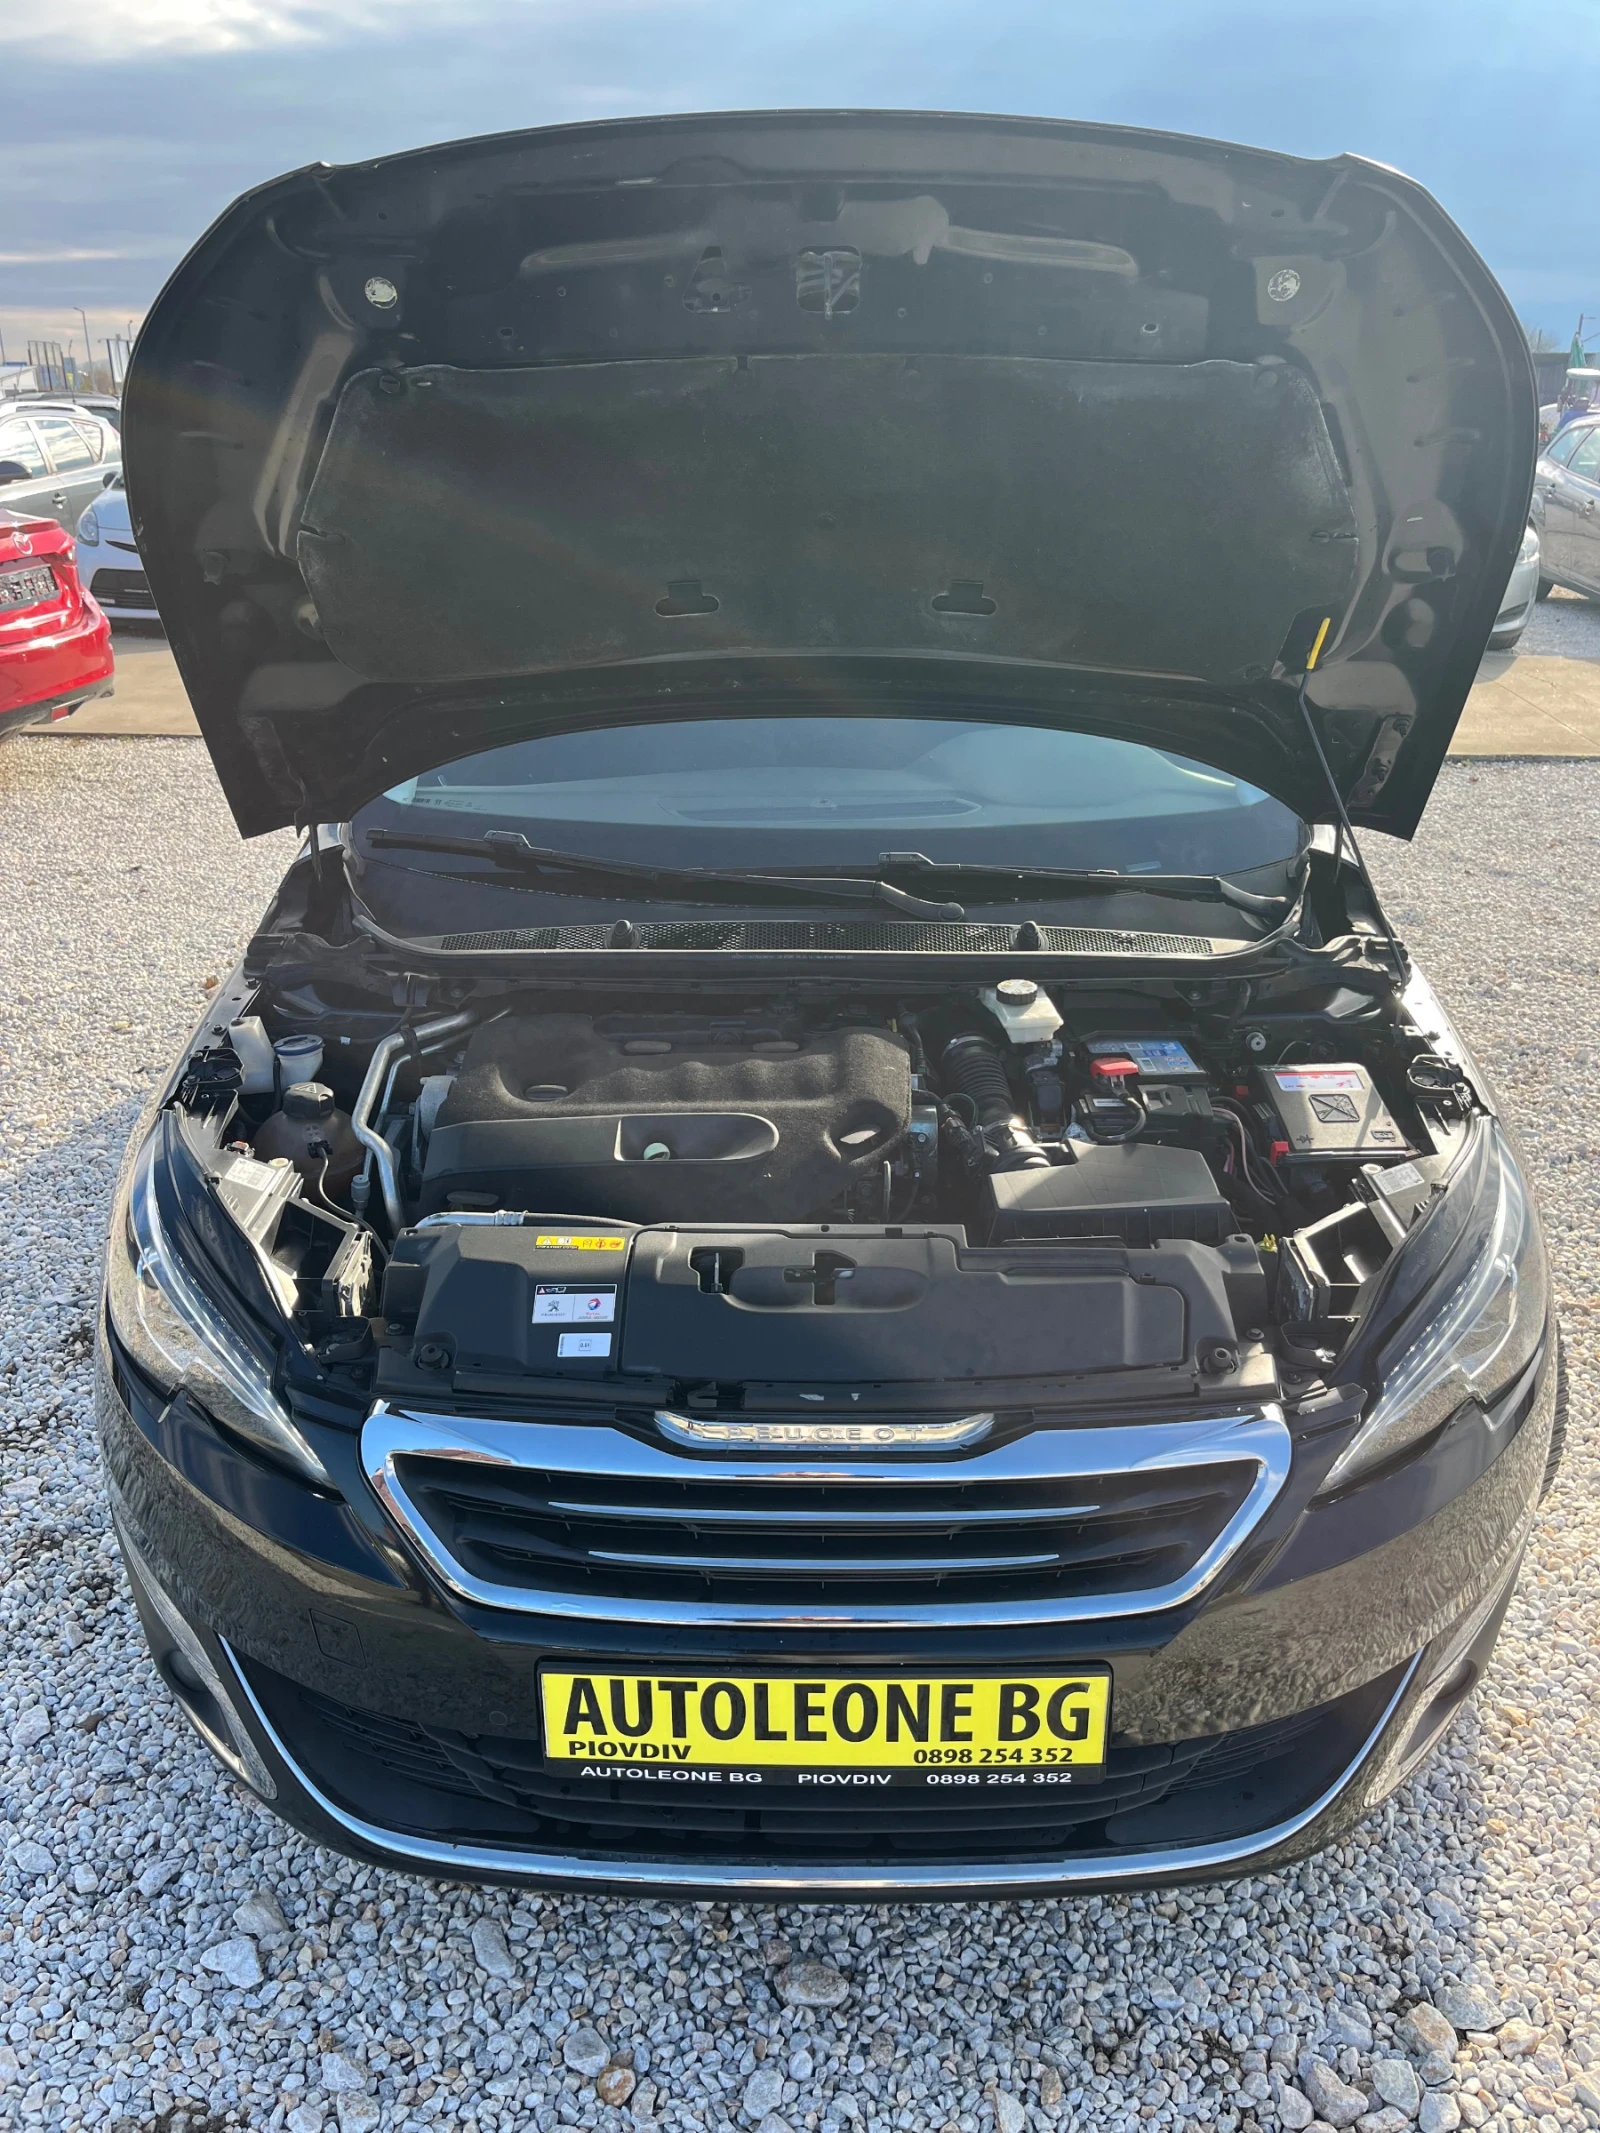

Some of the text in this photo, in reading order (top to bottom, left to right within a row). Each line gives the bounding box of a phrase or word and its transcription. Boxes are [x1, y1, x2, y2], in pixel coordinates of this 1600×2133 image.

[727, 1427, 923, 1441] PEUGEOT
[563, 1678, 1091, 1743] AUTOLEONE BG
[568, 1740, 692, 1760] PIOVDIV
[913, 1747, 1073, 1764] 0898 254 352
[580, 1766, 1072, 1785] AUTOLEONE BG PIOVDIV 0898 254 352
